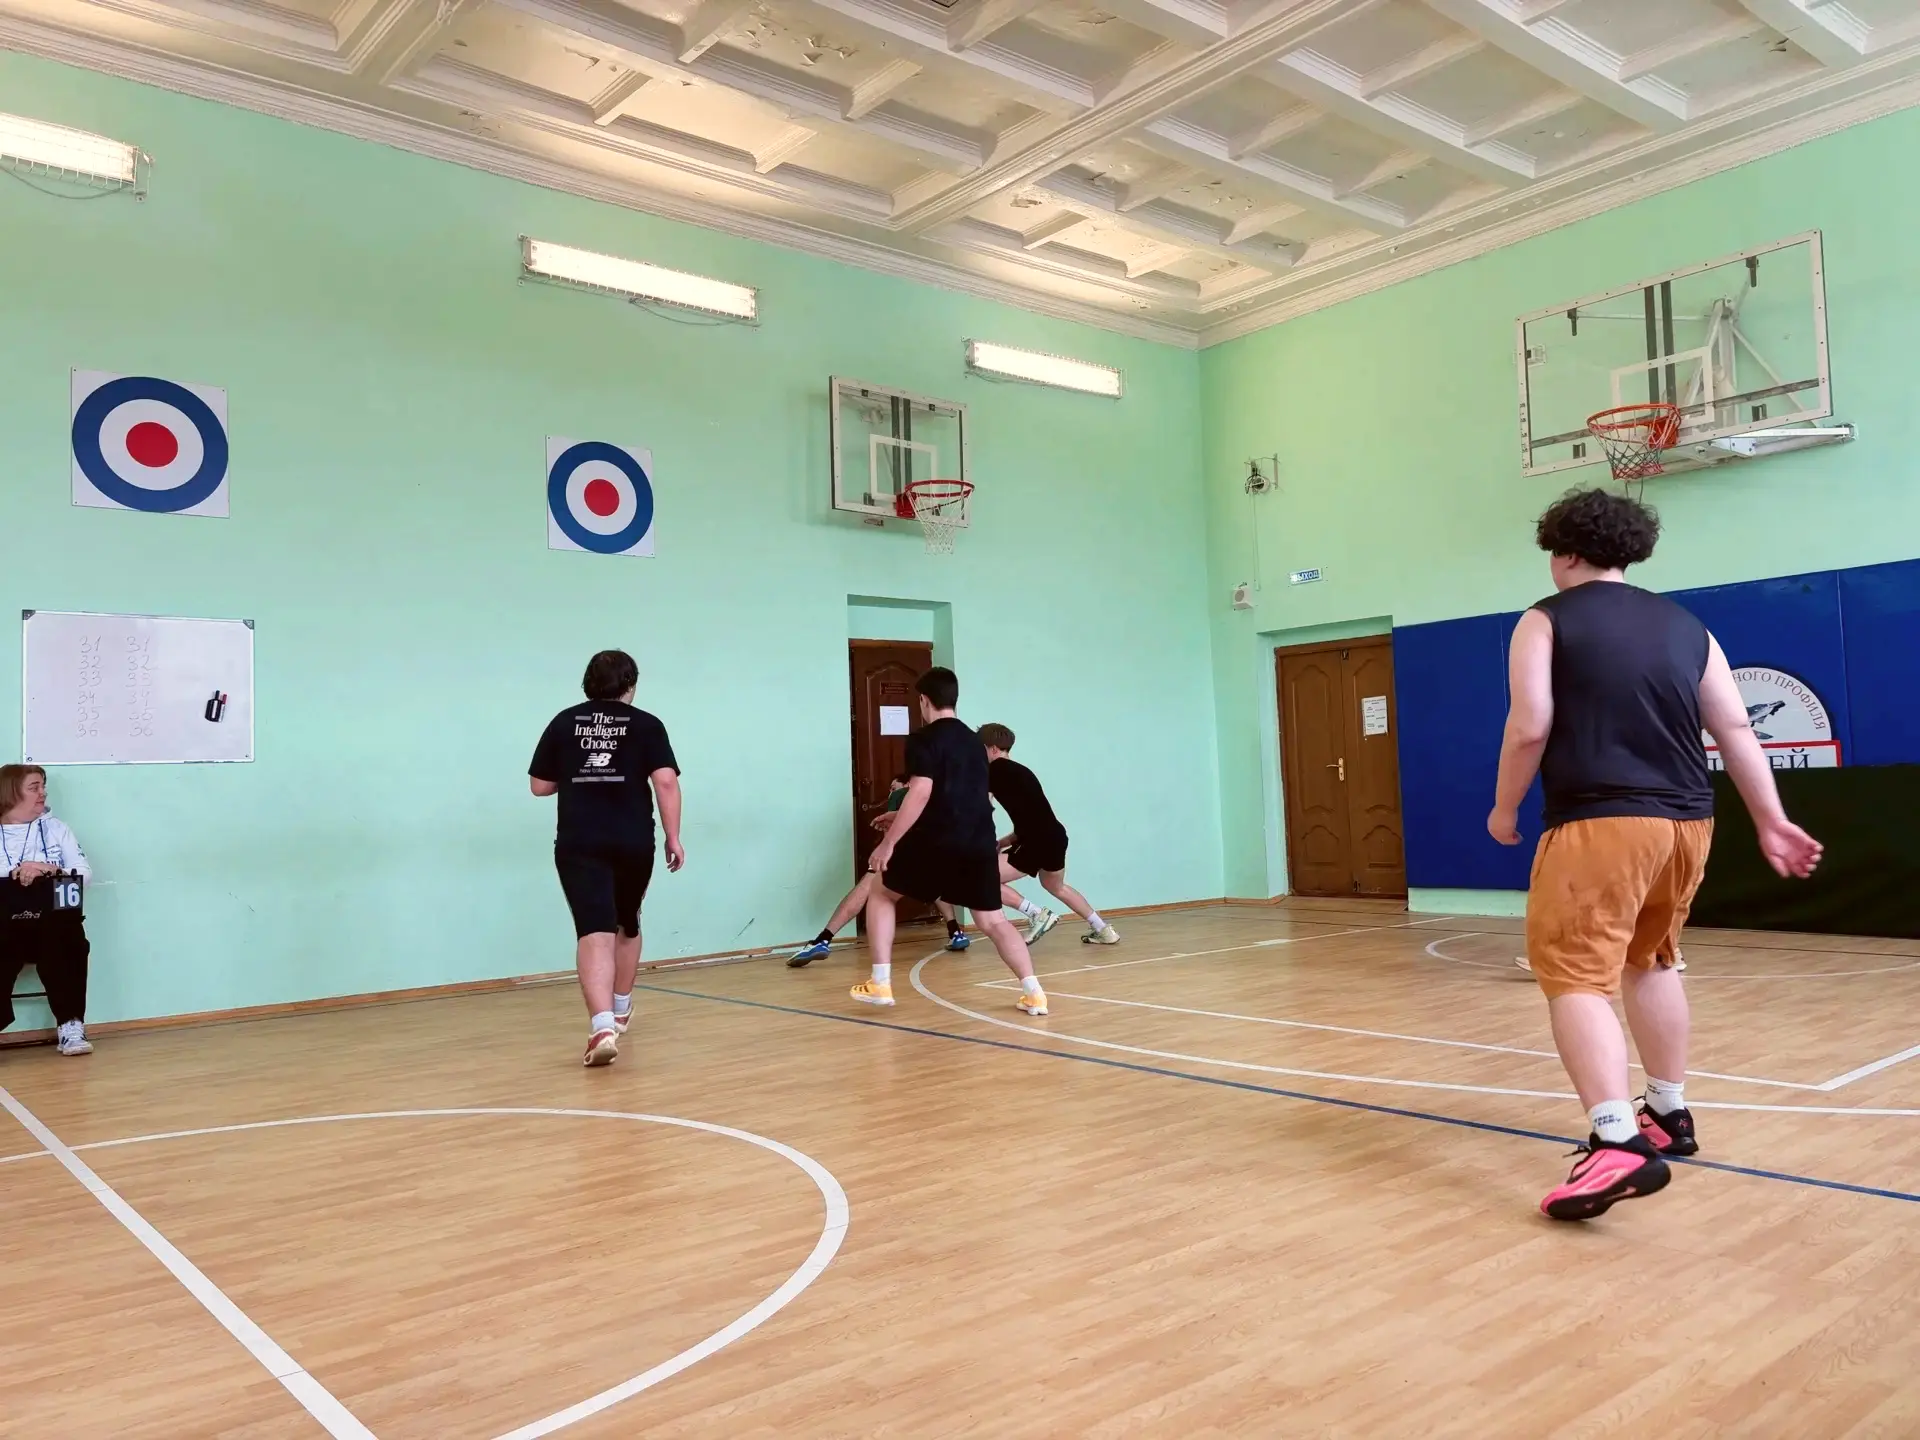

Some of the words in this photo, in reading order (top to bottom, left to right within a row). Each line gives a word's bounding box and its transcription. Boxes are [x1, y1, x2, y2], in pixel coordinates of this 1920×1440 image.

[79, 635, 102, 653] 31
[125, 635, 150, 652] 31
[77, 655, 103, 670] 32
[127, 655, 153, 671] 32
[78, 670, 102, 687] 33
[77, 690, 95, 704] 34
[1774, 676, 1826, 730] ПРОФИЛЯ
[77, 705, 102, 722] 35
[592, 712, 614, 724] The
[575, 724, 627, 739] Intelligent
[580, 737, 618, 749] Choice
[55, 882, 80, 907] 16
